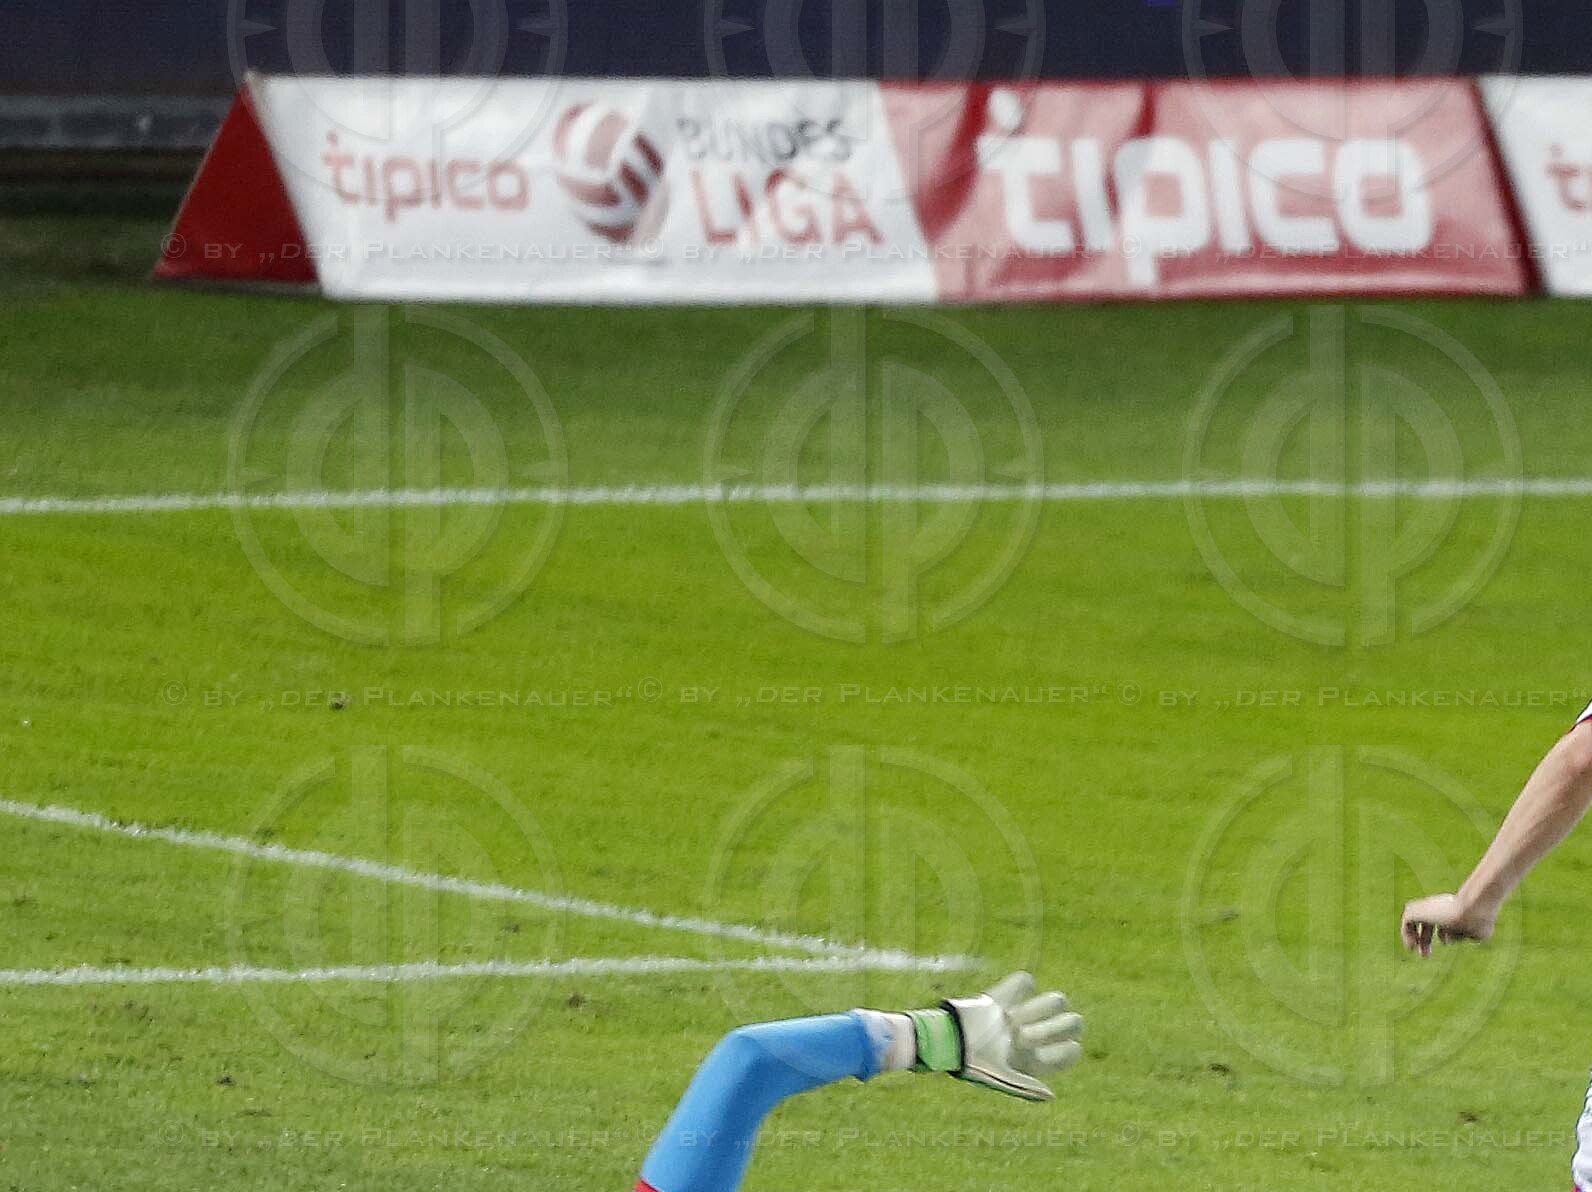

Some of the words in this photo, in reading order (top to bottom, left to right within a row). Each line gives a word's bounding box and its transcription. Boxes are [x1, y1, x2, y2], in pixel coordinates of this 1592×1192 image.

[324, 132, 532, 222] tipico
[691, 167, 884, 246] LIGA
[975, 89, 1433, 289] tipico
